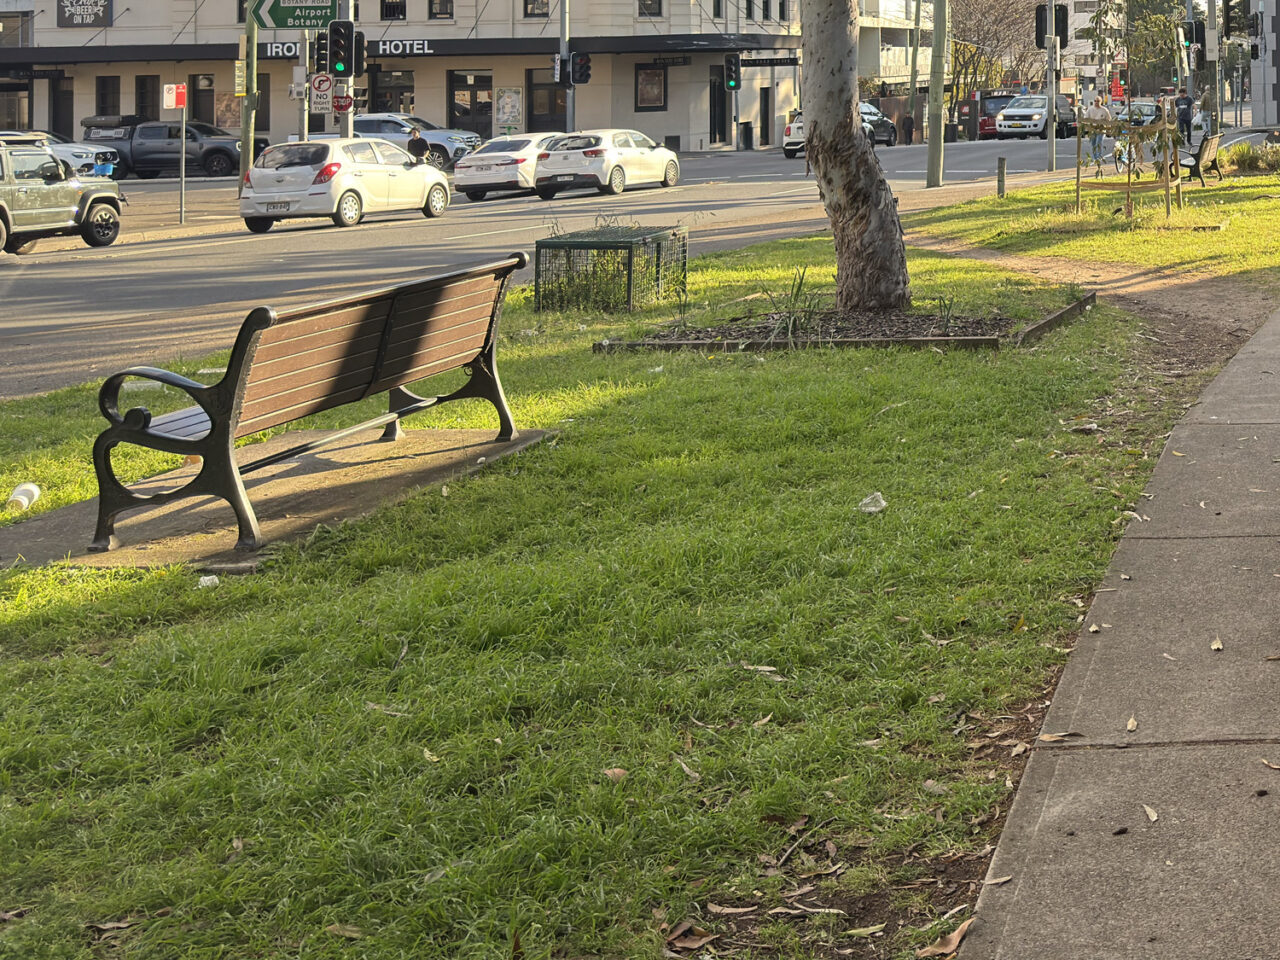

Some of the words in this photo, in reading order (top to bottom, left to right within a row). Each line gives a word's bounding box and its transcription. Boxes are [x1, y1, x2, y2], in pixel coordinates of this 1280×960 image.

[76, 5, 93, 15] BEER
[294, 8, 331, 18] Airport
[73, 14, 82, 24] ON
[82, 14, 95, 24] TAP
[287, 18, 323, 27] Botany
[379, 41, 434, 54] HOTEL
[333, 98, 351, 106] STOP
